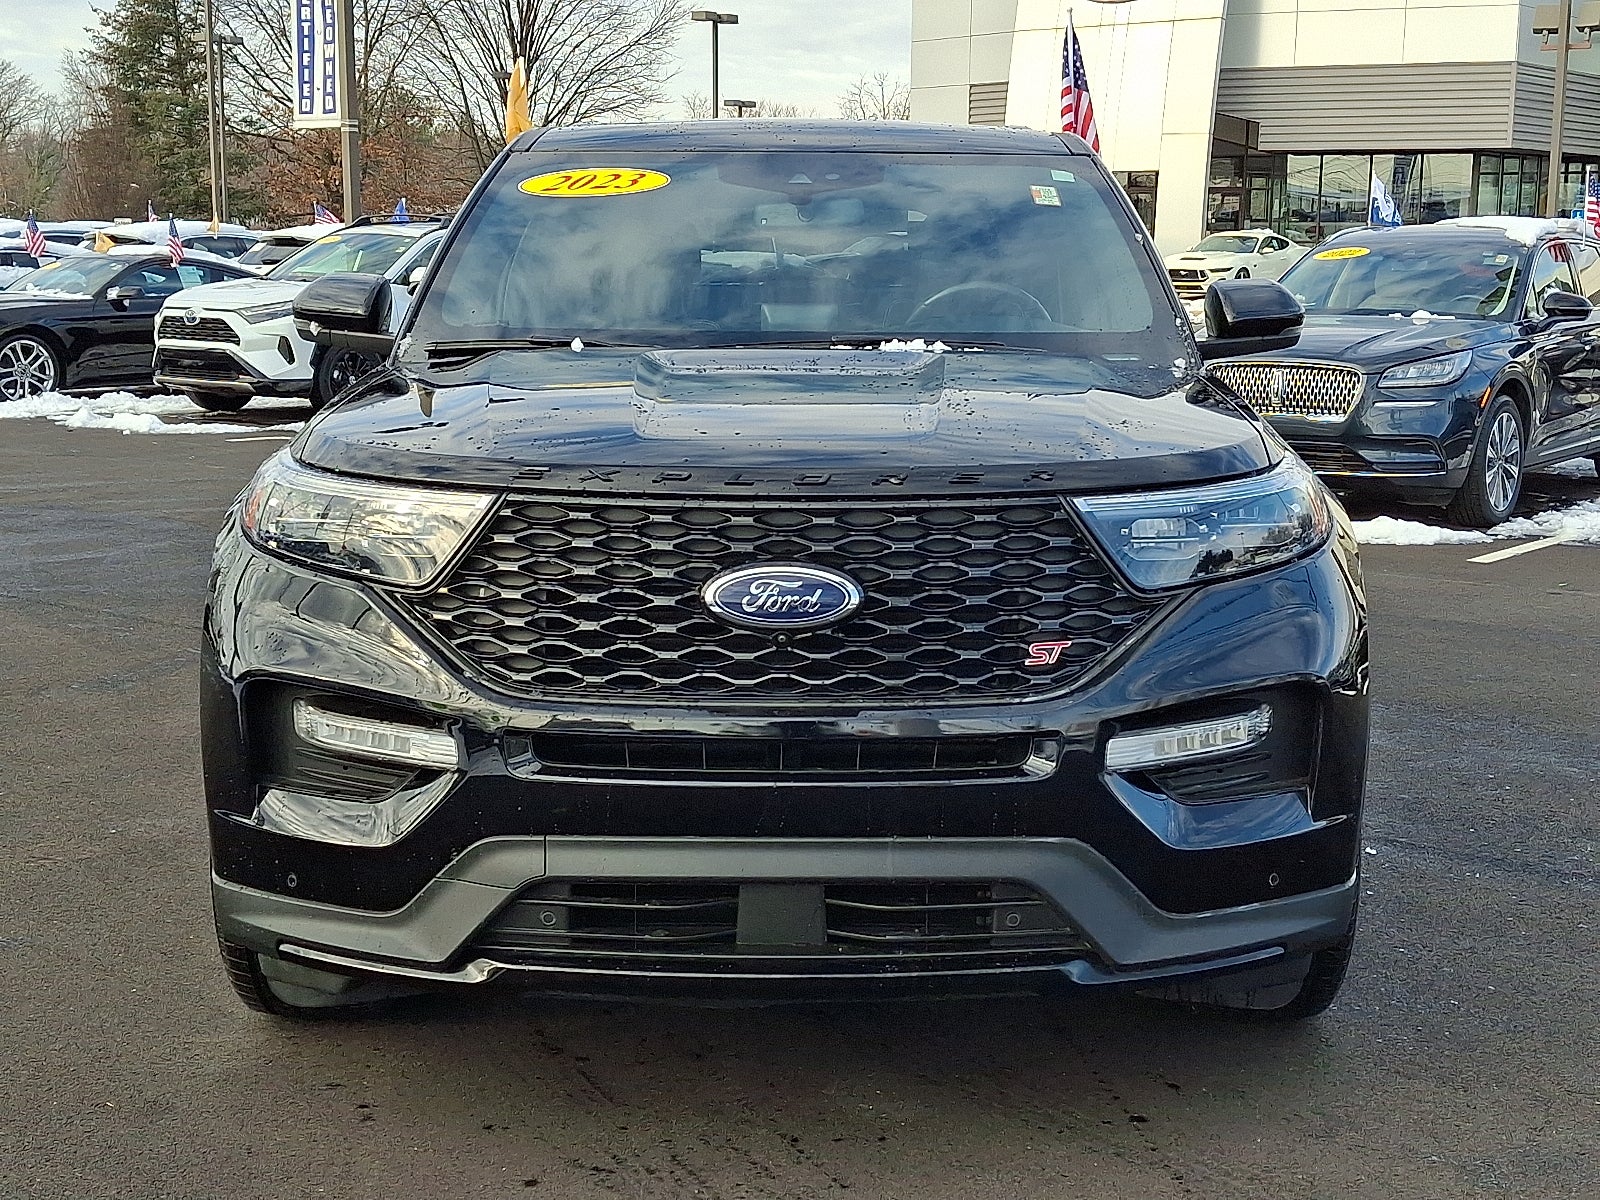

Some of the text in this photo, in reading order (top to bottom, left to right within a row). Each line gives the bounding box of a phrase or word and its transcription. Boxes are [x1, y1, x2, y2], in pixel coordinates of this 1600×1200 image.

[540, 173, 647, 191] 2023
[508, 466, 1057, 486] EXPLORER
[741, 579, 823, 613] Ford
[1025, 641, 1073, 666] ST
